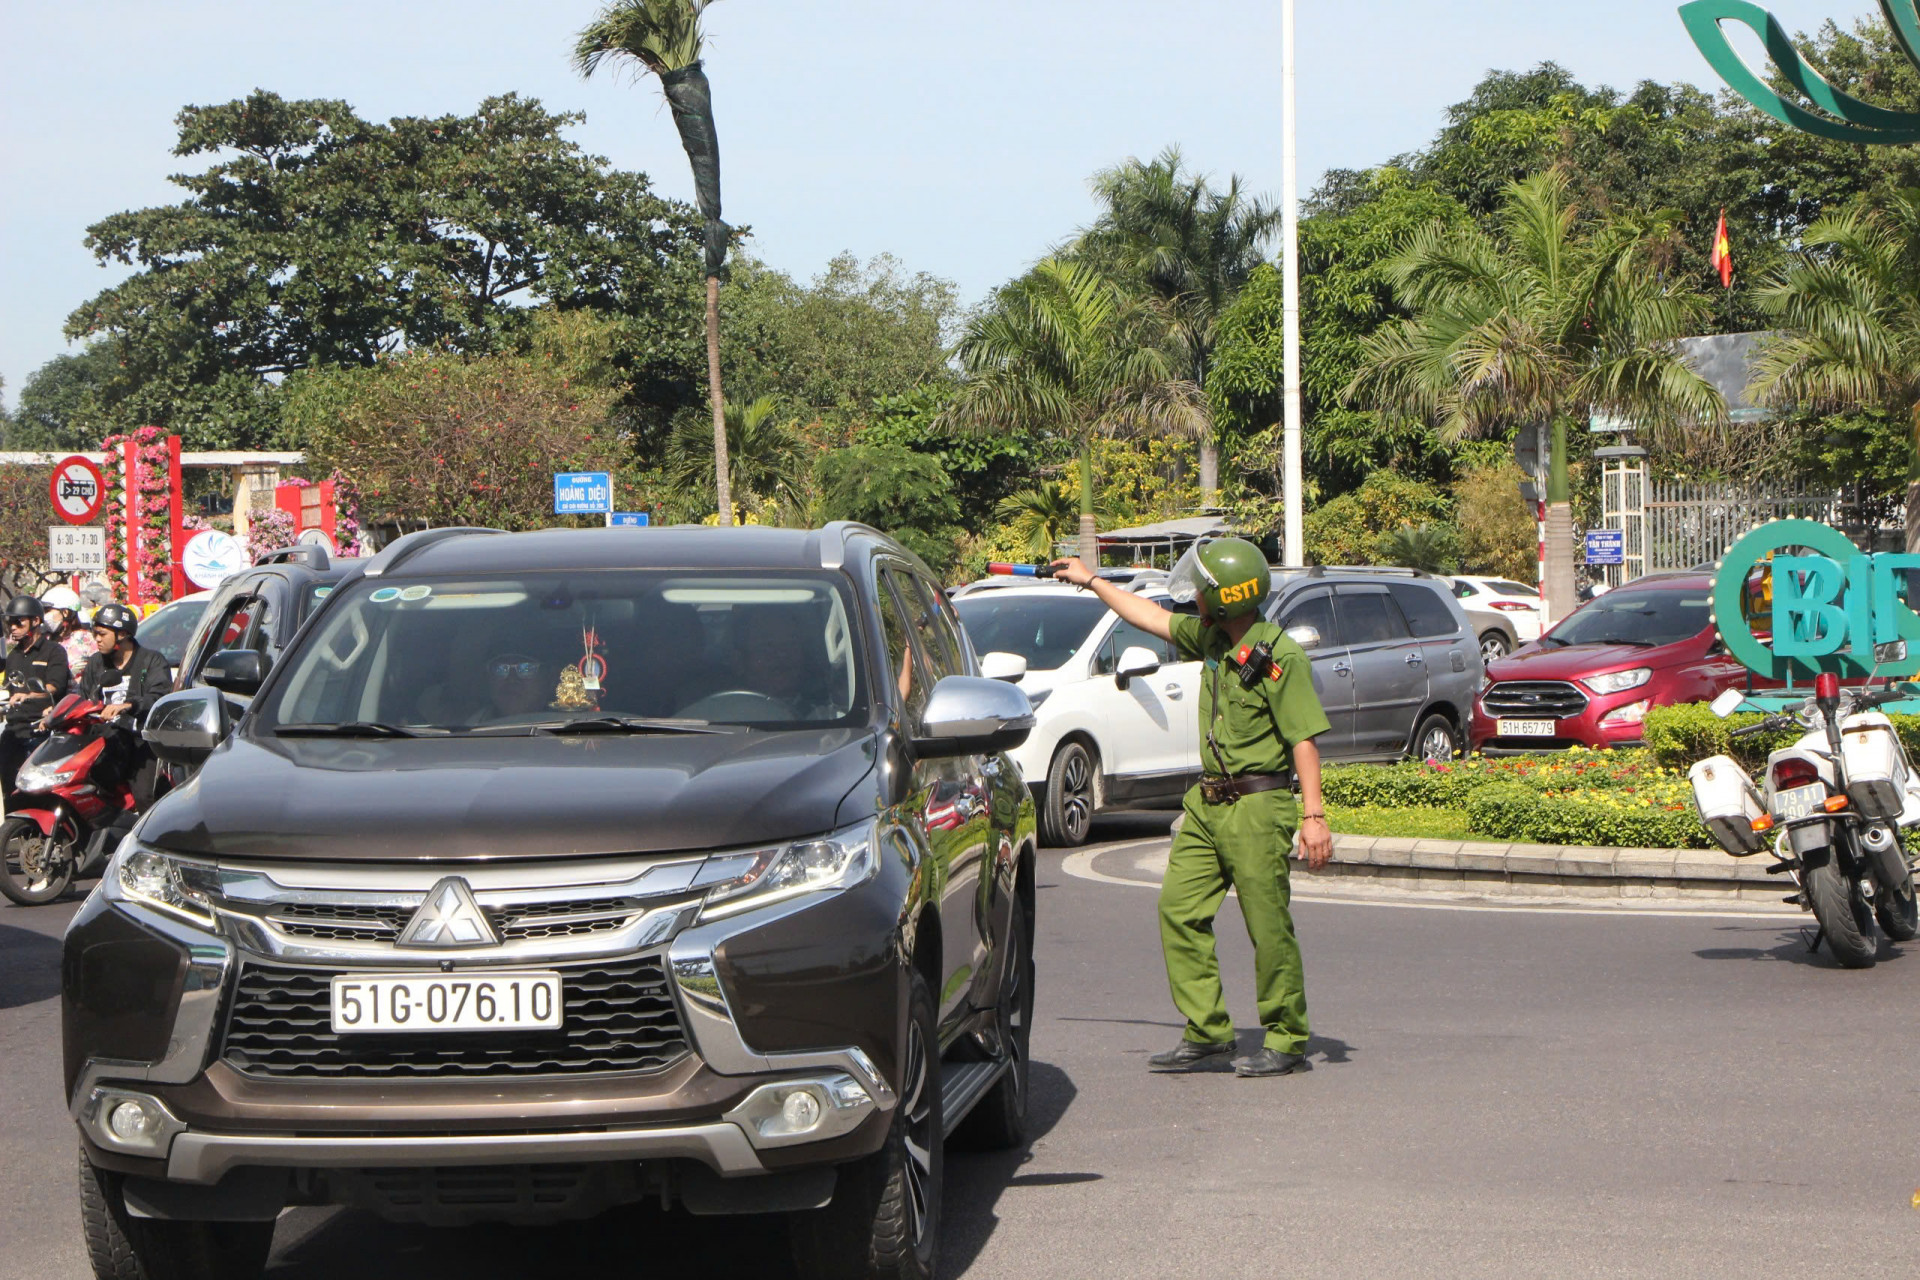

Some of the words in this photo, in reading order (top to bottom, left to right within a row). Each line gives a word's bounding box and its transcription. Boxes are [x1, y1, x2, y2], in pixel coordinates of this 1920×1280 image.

[72, 486, 80, 495] 29
[559, 485, 584, 501] HOÀNG
[588, 484, 606, 502] DIỆU
[56, 533, 74, 545] 6:30
[81, 533, 98, 545] 7:30
[55, 552, 74, 564] 16:30
[81, 552, 101, 564] 18:30
[1219, 577, 1260, 605] CSTT
[341, 981, 553, 1025] 51G-076.10
